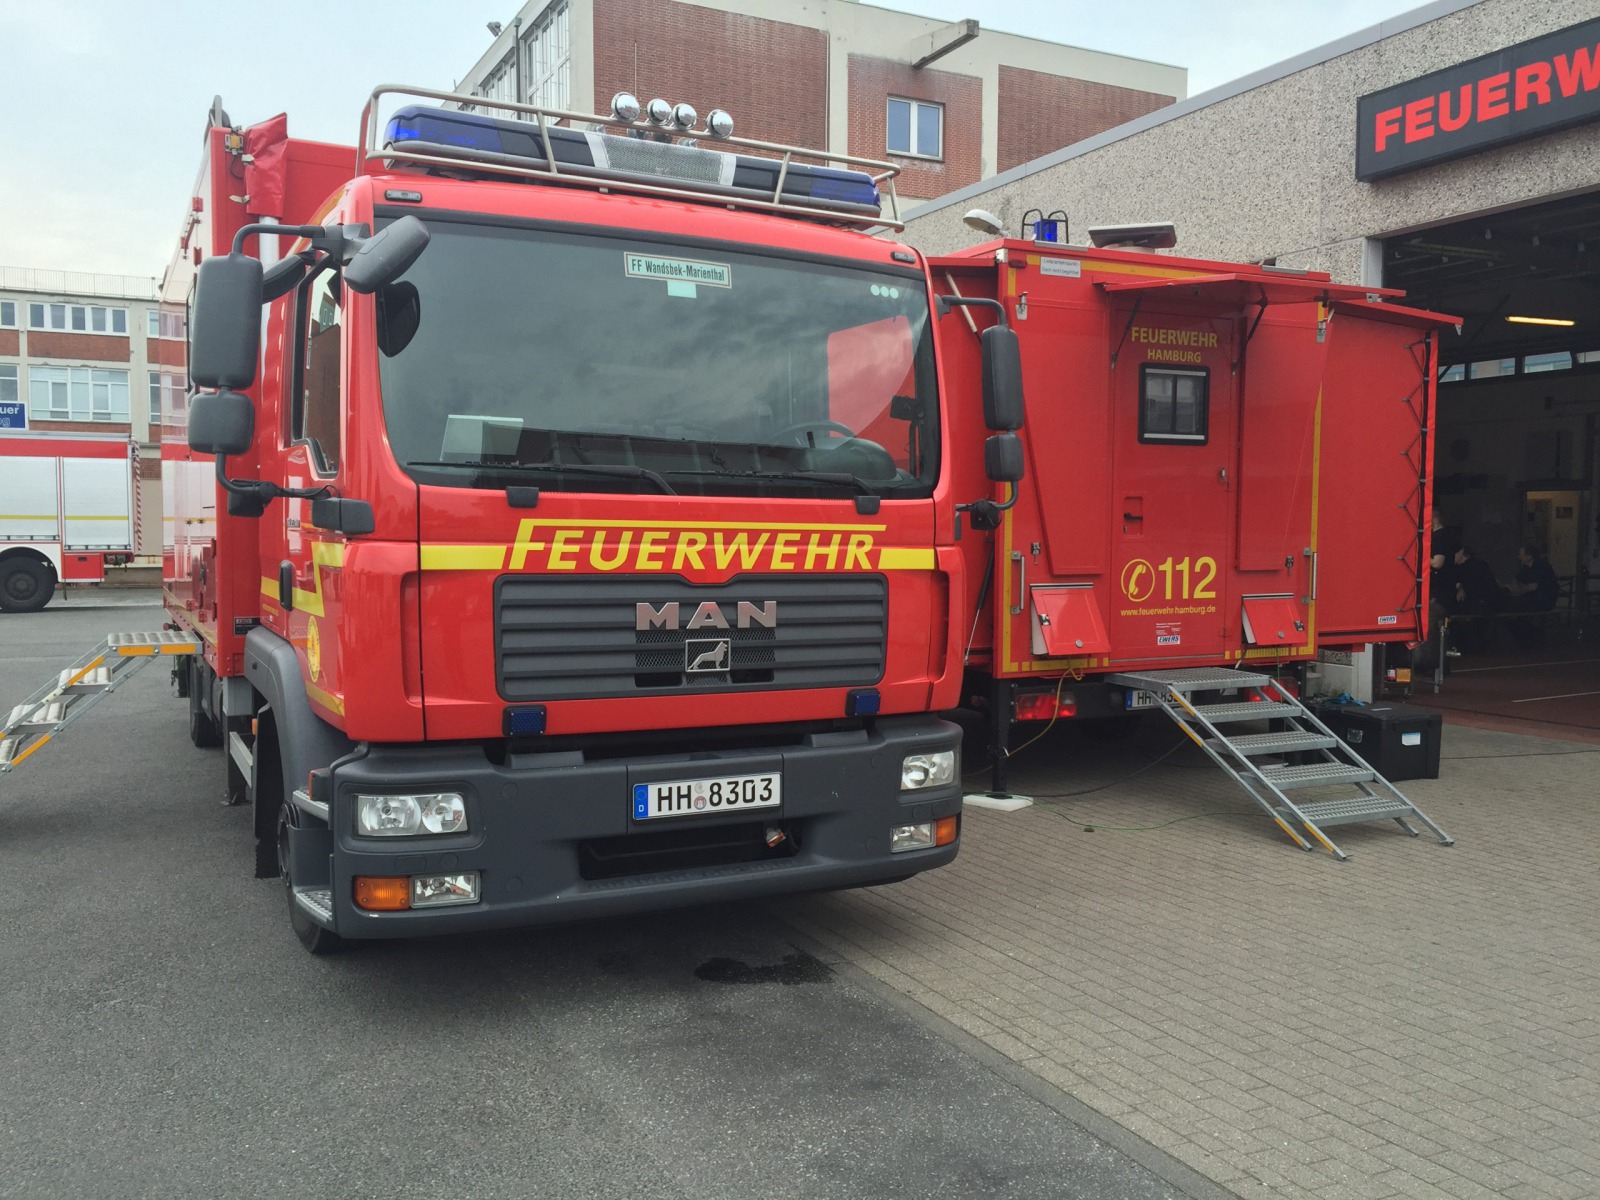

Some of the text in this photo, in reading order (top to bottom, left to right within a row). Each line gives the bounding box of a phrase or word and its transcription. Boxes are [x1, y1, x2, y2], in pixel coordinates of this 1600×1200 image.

[1375, 43, 1600, 153] FEUERW
[632, 259, 725, 281] FF Wandsbek-Marienthal
[1131, 327, 1218, 348] FEUERWEHR
[1147, 349, 1202, 363] HAMBURG
[508, 518, 887, 570] FEUERWEHR
[1158, 556, 1216, 600] 112
[636, 601, 776, 630] MAN
[1120, 605, 1216, 616] www.feuerwehr-hamburg.de
[638, 778, 772, 812] D HH 8303
